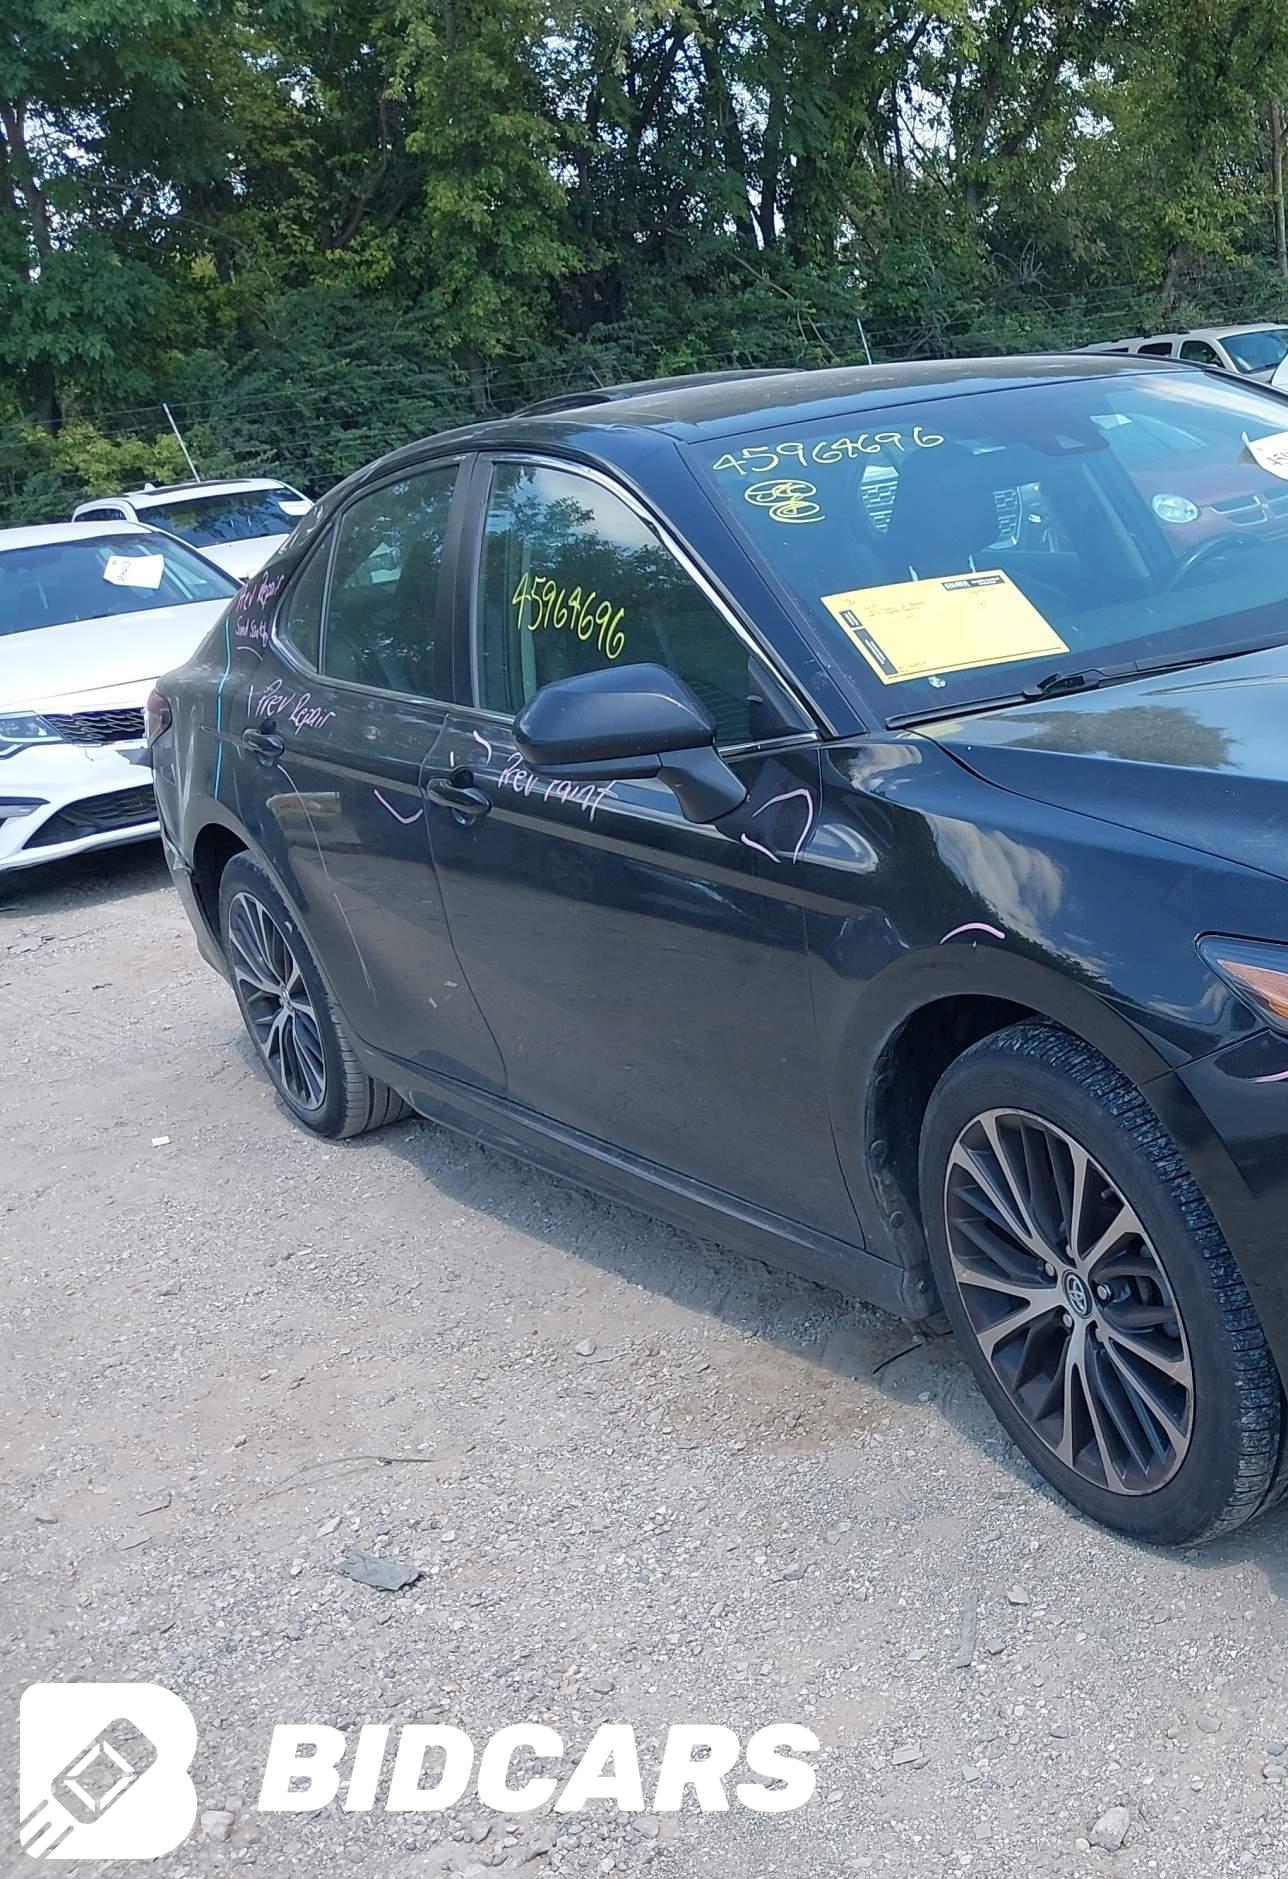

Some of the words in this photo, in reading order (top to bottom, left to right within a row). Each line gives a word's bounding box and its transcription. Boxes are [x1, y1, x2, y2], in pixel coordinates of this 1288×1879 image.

[713, 426, 945, 476] 45964696
[511, 571, 626, 660] 45964696
[255, 678, 297, 718] Prev
[288, 692, 337, 736] Repair
[498, 751, 540, 797] Prev
